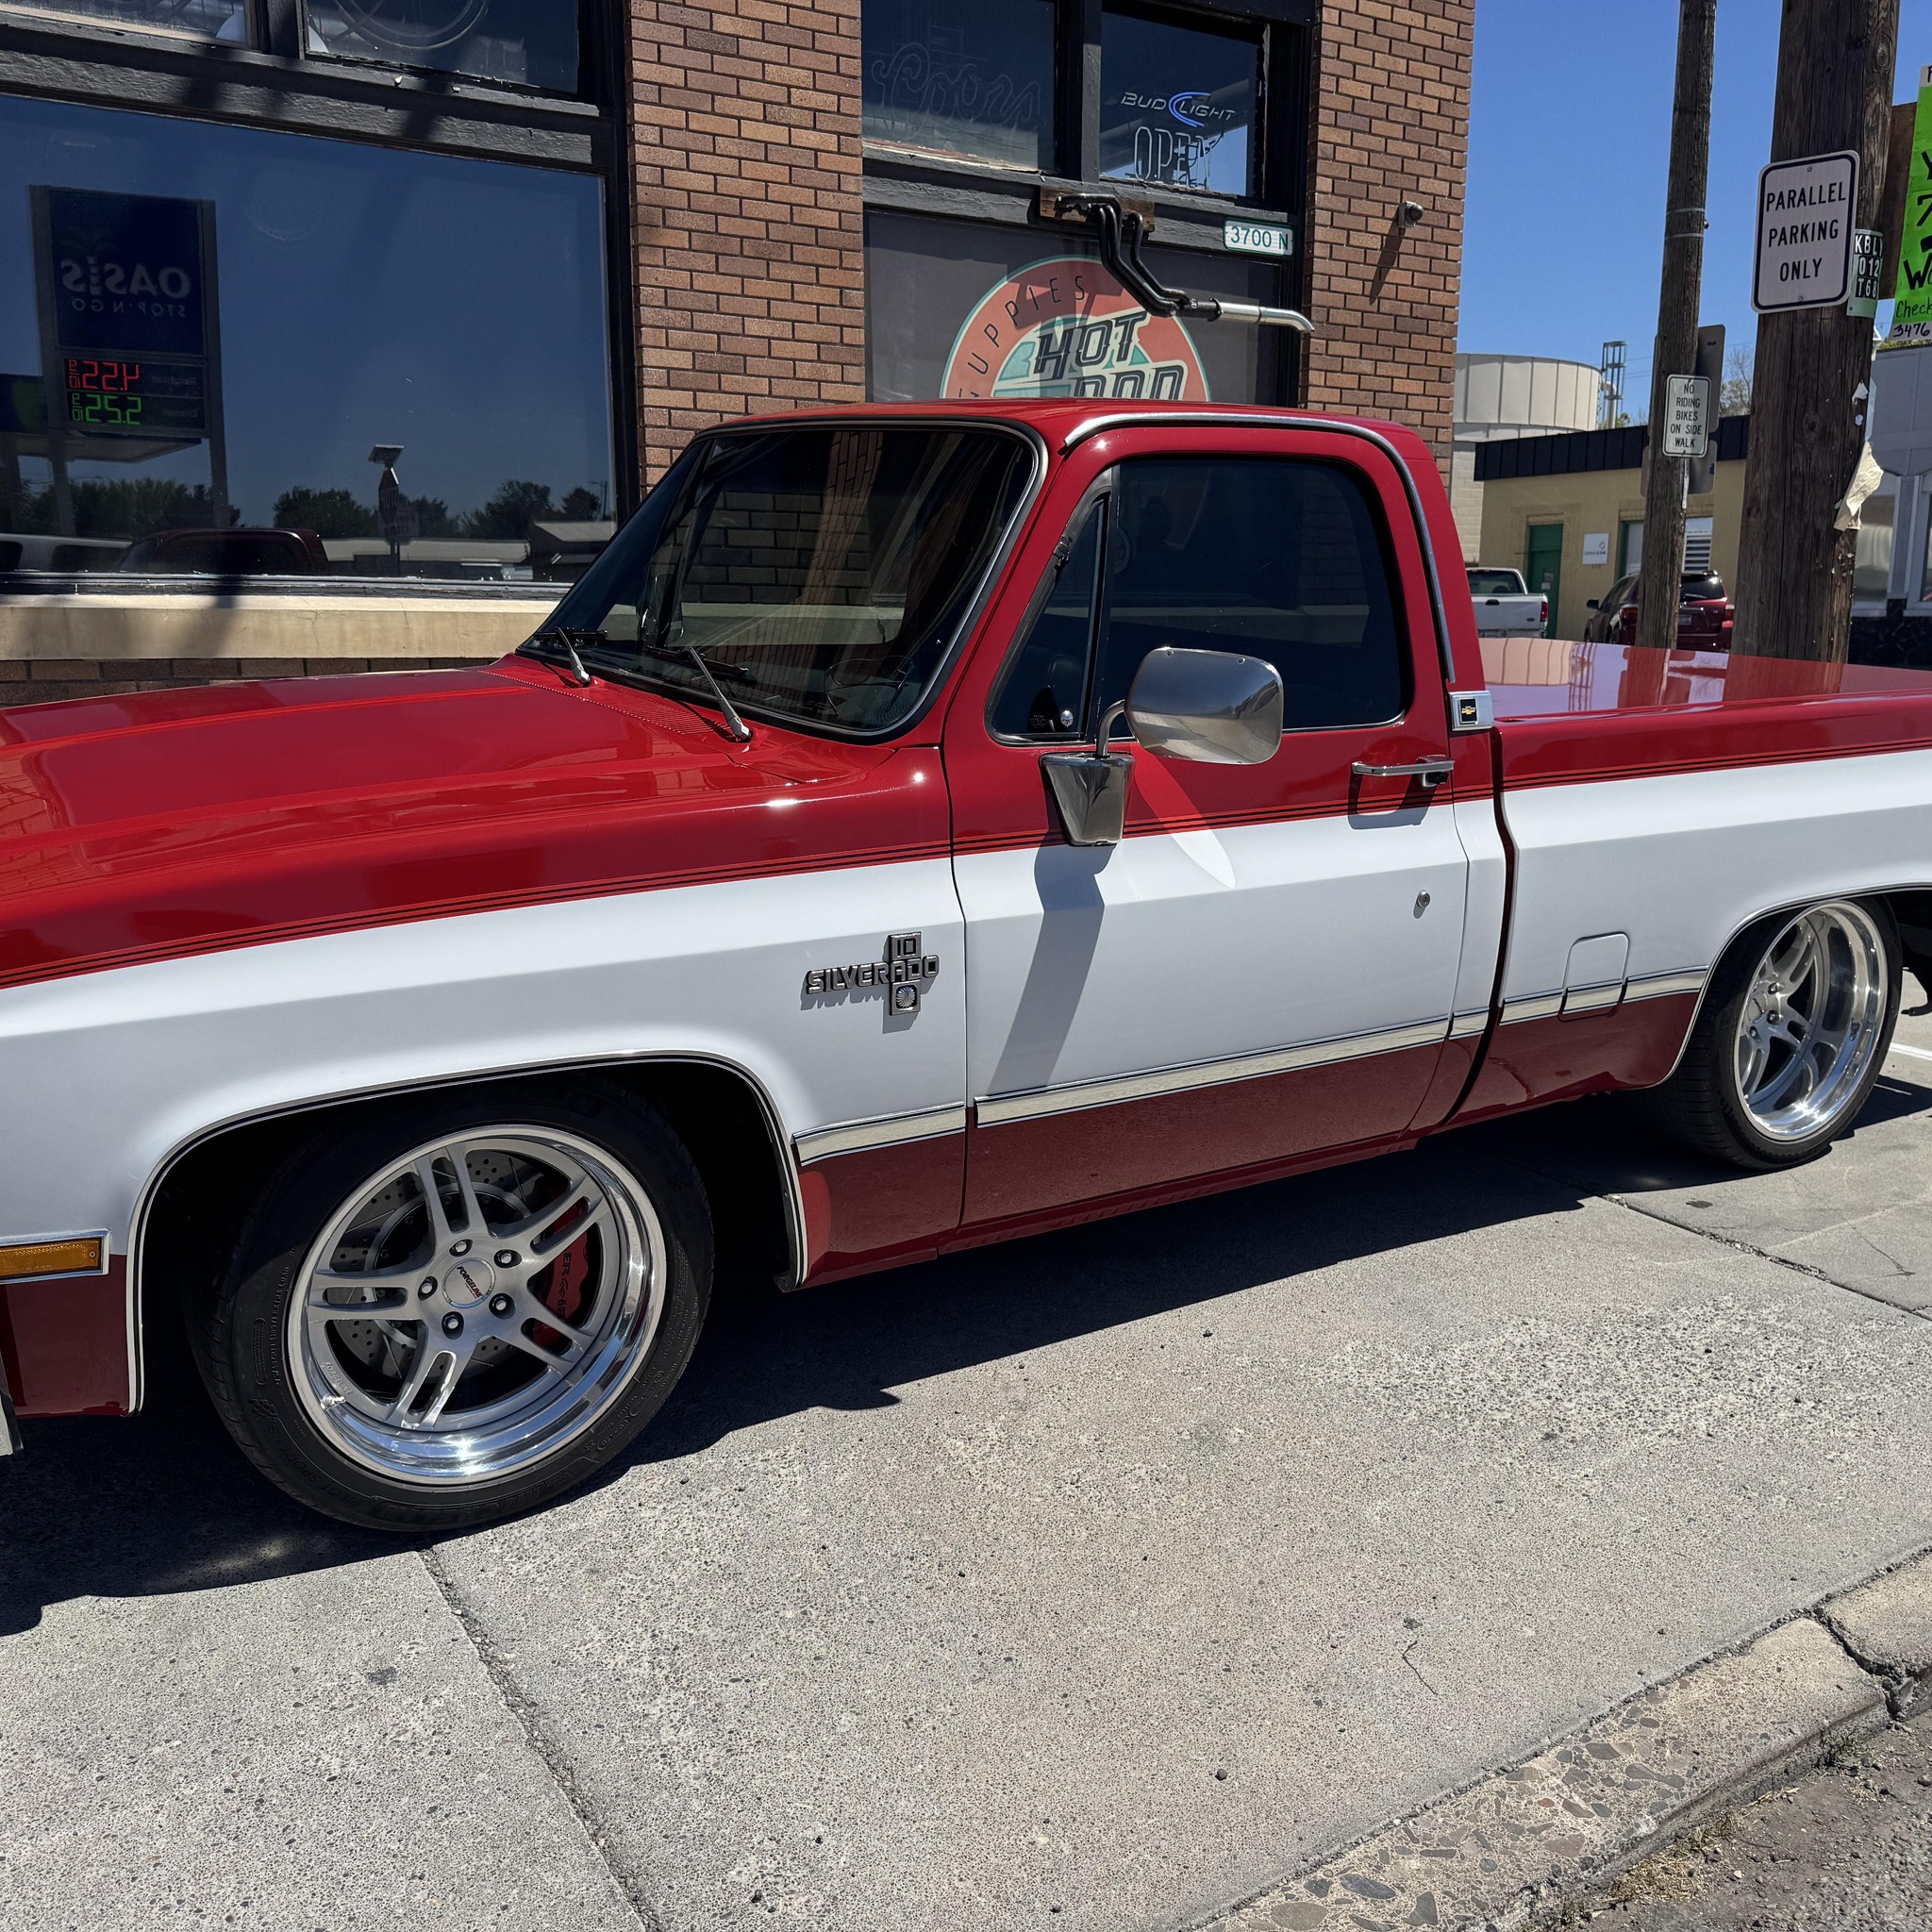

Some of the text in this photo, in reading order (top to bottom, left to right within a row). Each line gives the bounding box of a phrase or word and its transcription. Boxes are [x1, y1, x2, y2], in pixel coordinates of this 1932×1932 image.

[1121, 92, 1236, 121] BUD LIGHT
[1766, 181, 1846, 212] PARALLEL
[1230, 225, 1289, 251] 3700 N
[1768, 219, 1840, 248] PARKING
[1779, 258, 1823, 282] ONLY
[1892, 322, 1930, 338] 3476
[1034, 310, 1148, 380] HOT
[1683, 384, 1695, 394] NO
[1675, 397, 1701, 408] RIDING
[1675, 410, 1699, 422] BIKES
[1670, 424, 1703, 435] ON SIDE
[1674, 437, 1696, 448] WALK
[896, 937, 917, 958] 10
[807, 955, 940, 994] SILVERADO
[457, 1266, 483, 1299] FORGELINE
[321, 1361, 355, 1395] FORGELINE
[282, 1447, 322, 1484] SPORT
[319, 1481, 363, 1507] PILOT
